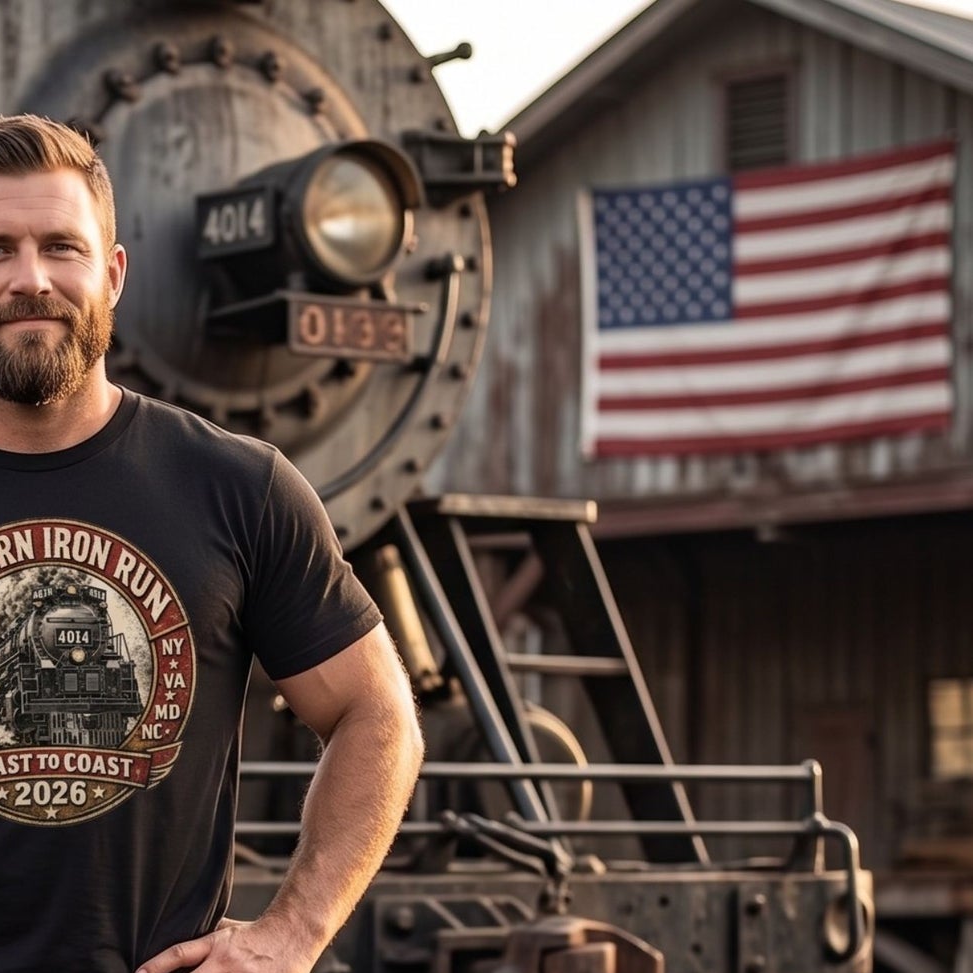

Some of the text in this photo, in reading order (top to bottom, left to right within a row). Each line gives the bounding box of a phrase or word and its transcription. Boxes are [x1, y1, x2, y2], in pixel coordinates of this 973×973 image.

[203, 198, 265, 245] 4014
[43, 527, 112, 571] IRON
[113, 548, 172, 623] RUN
[58, 630, 89, 644] 4014
[161, 638, 184, 656] NY
[163, 673, 186, 689] VA
[155, 704, 180, 720] MD
[141, 723, 163, 740] NC
[36, 753, 60, 770] TO
[63, 752, 134, 777] COAST
[14, 780, 87, 806] 2026
